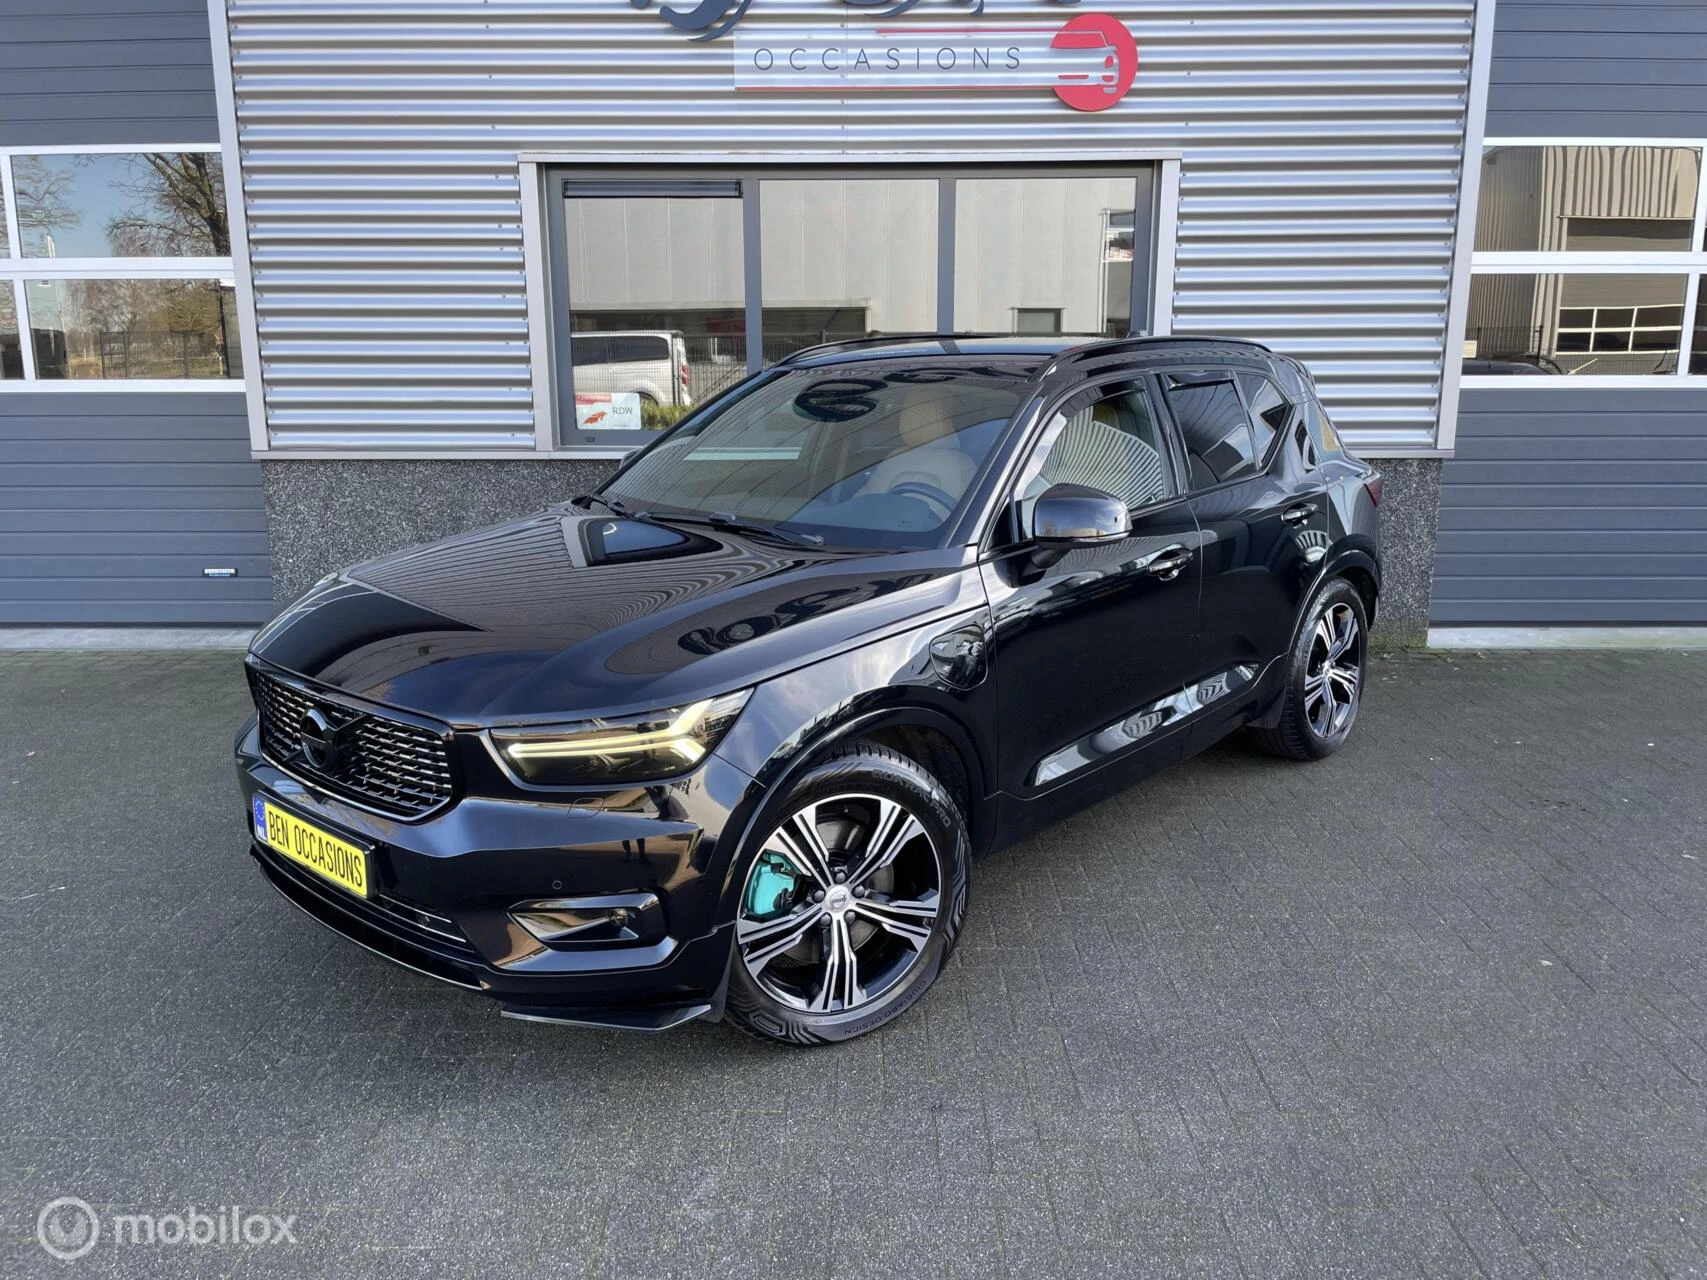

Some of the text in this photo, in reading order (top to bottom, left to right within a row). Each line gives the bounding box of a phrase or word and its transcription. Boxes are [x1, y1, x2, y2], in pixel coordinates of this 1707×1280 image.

[753, 46, 1020, 71] OCCASIONS
[268, 810, 363, 888] BEN OCCASIONS
